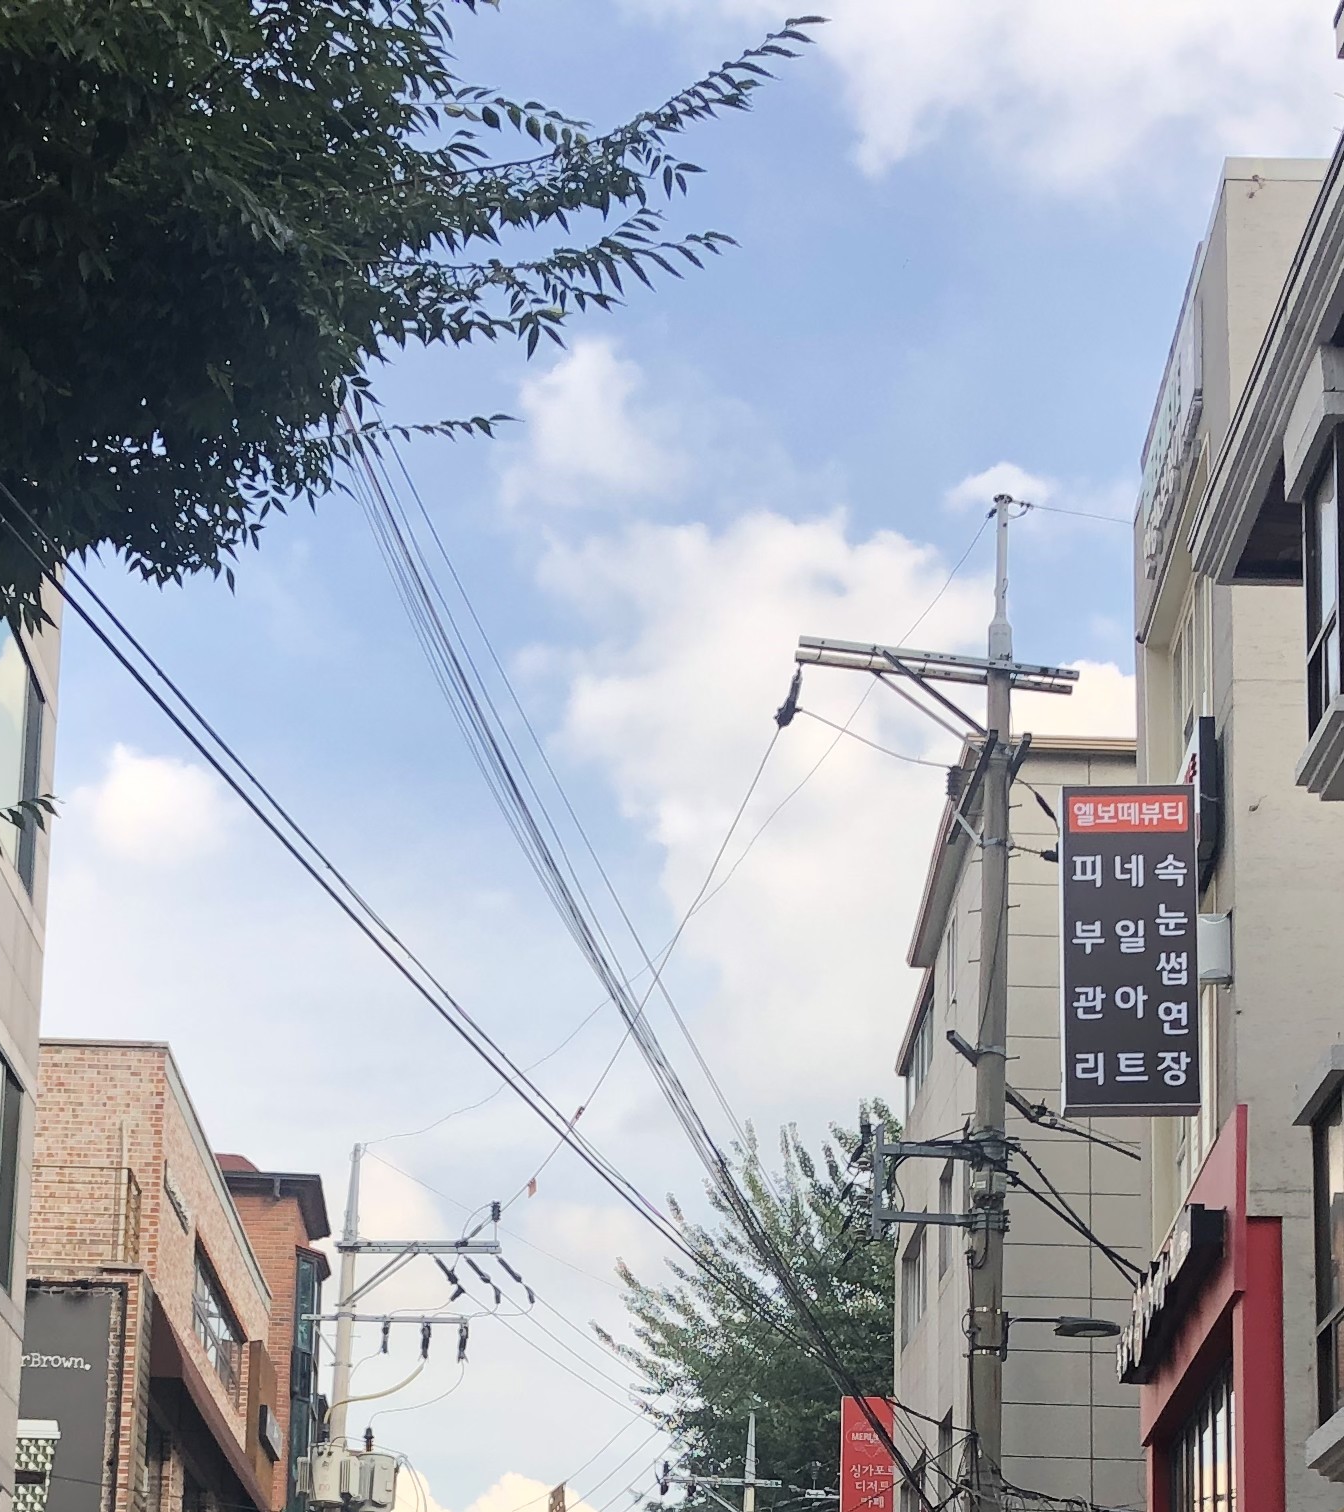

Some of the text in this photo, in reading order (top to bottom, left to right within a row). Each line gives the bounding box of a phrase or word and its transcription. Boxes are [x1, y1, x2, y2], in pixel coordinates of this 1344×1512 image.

[1073, 801, 1184, 827] 엘보떼뷰티
[1071, 853, 1106, 1086] 피부관리
[1114, 853, 1149, 1082] 네일아트
[1154, 853, 1191, 1086] 속눈썹연장
